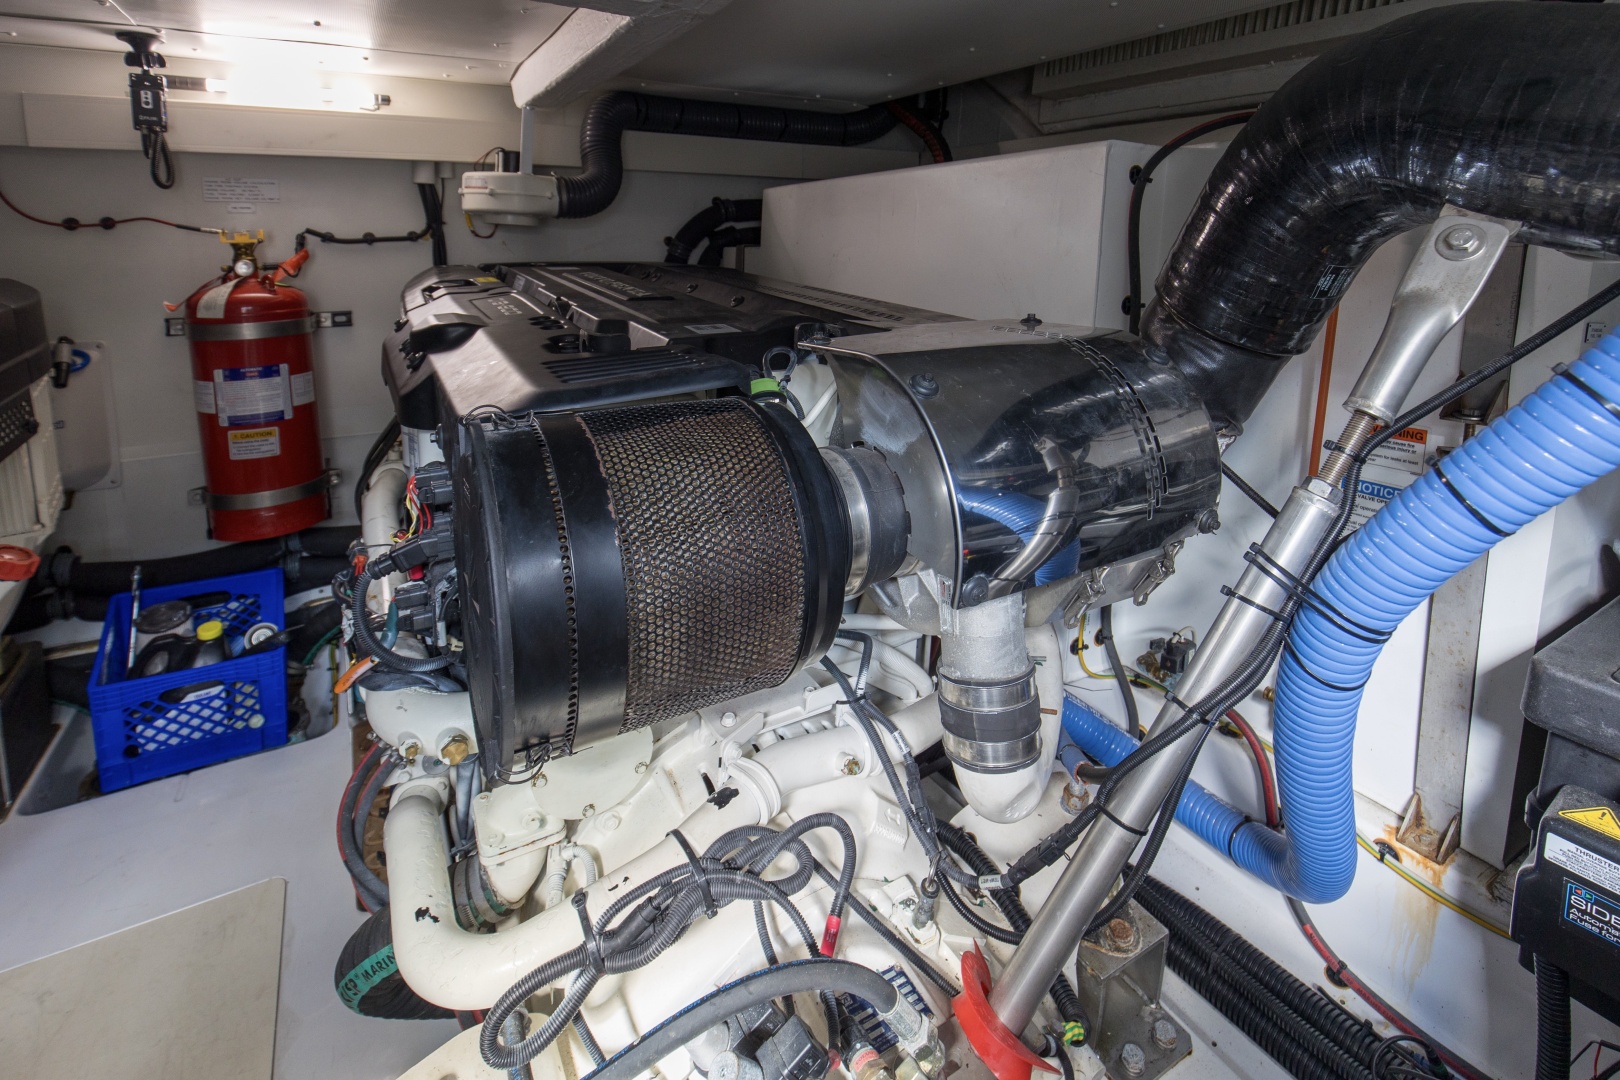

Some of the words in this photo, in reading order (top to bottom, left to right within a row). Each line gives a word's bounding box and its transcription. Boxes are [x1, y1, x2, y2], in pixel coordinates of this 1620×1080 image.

[239, 431, 273, 439] CAUTION
[1357, 493, 1376, 502] VALVE
[1570, 913, 1600, 933] Fuse
